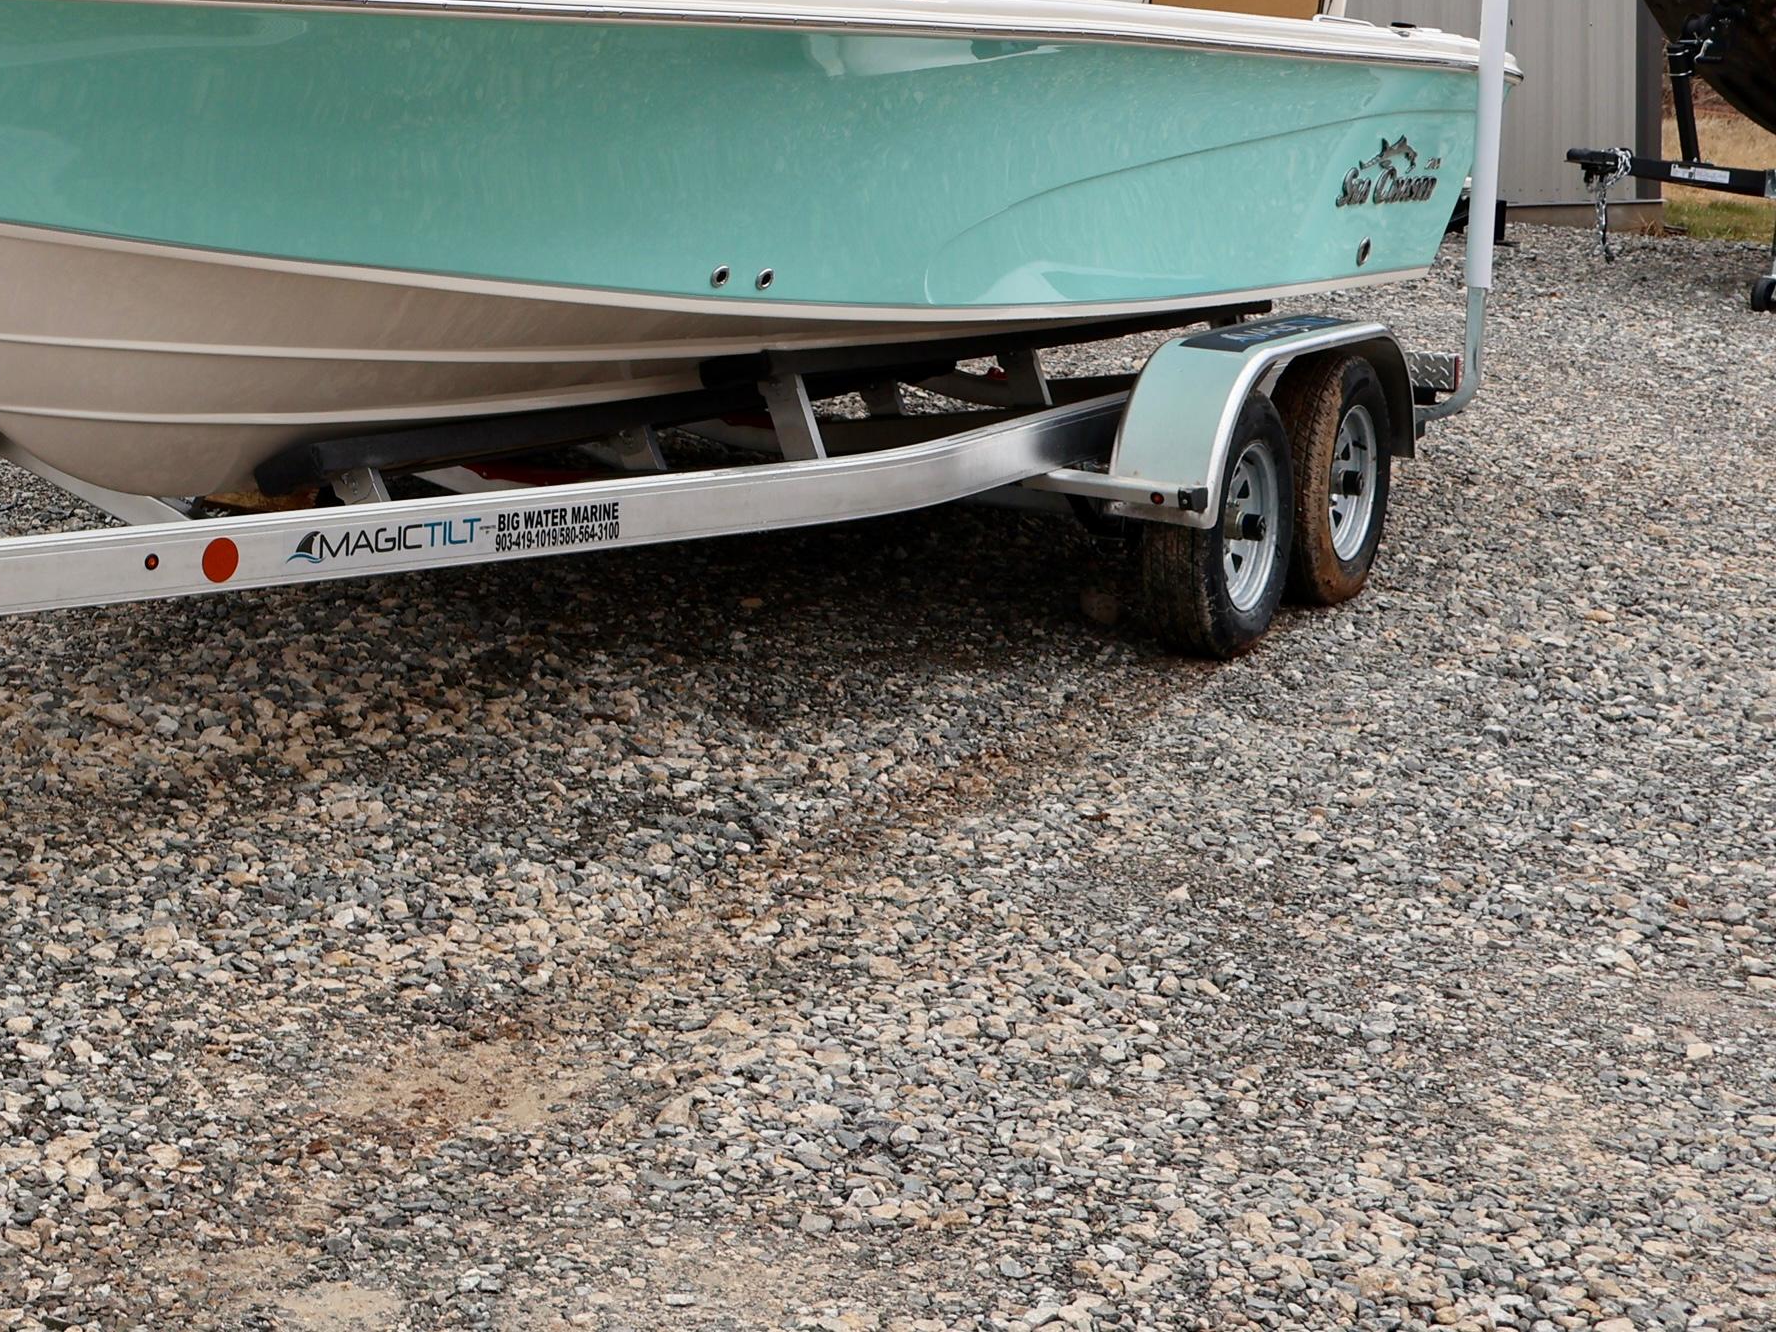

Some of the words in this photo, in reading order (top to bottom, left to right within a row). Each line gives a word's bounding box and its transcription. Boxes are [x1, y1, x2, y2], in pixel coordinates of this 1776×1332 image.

[497, 512, 520, 532] BIG
[523, 507, 568, 529] WATER
[571, 502, 620, 525] MARINE
